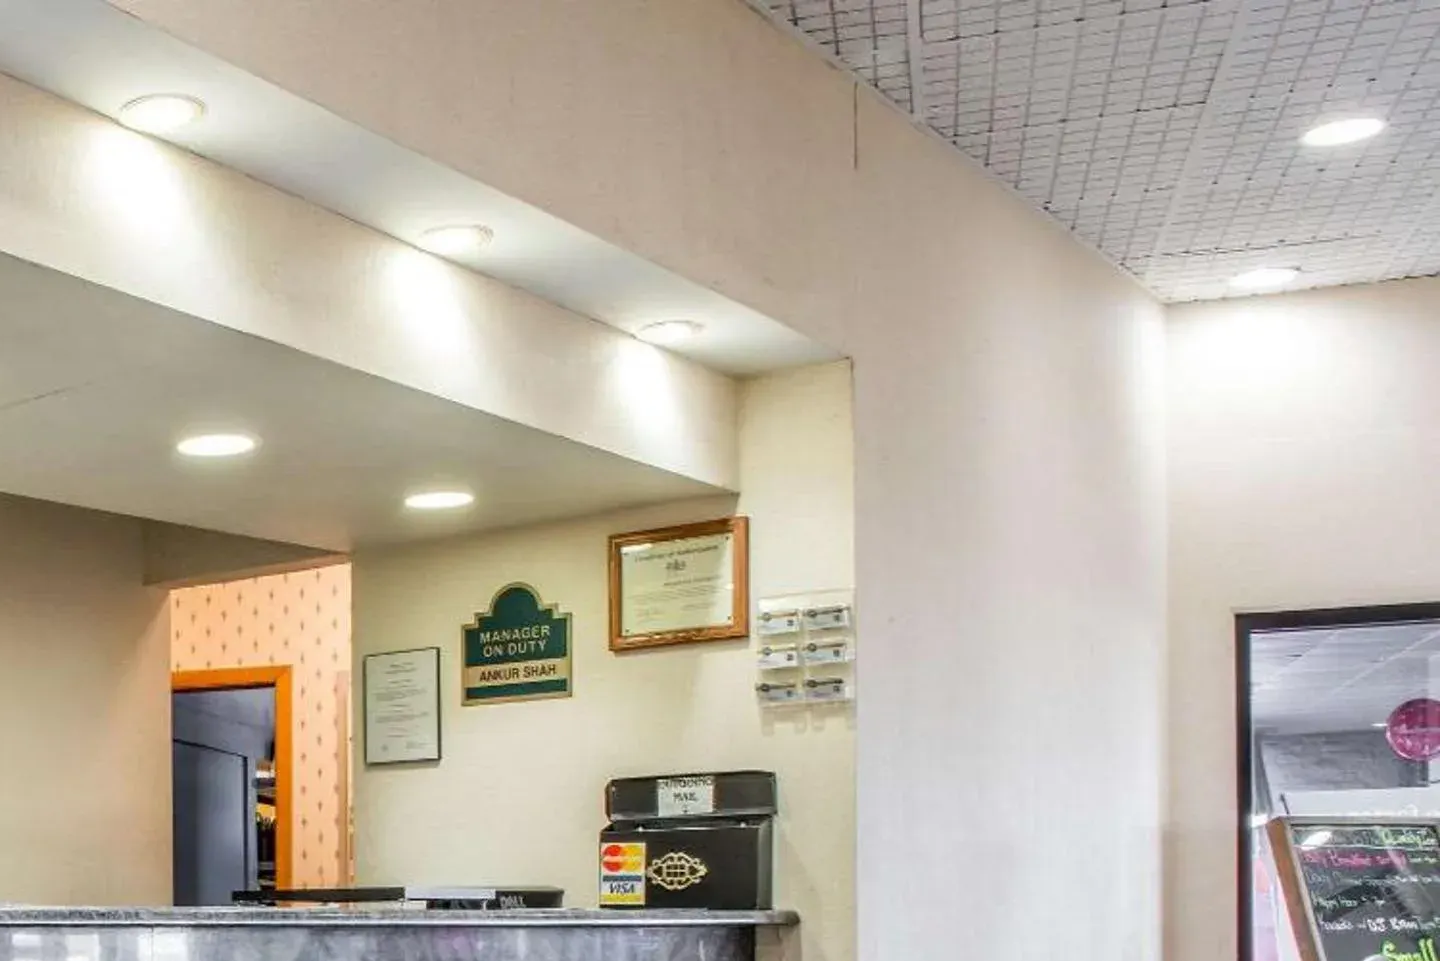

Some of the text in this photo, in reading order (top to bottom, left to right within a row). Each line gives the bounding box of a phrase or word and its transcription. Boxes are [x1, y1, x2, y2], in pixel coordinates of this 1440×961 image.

[479, 624, 551, 644] MANAGER
[482, 639, 547, 658] ON DUTY
[479, 663, 557, 682] ANKUR SHAH
[609, 882, 636, 894] VISA
